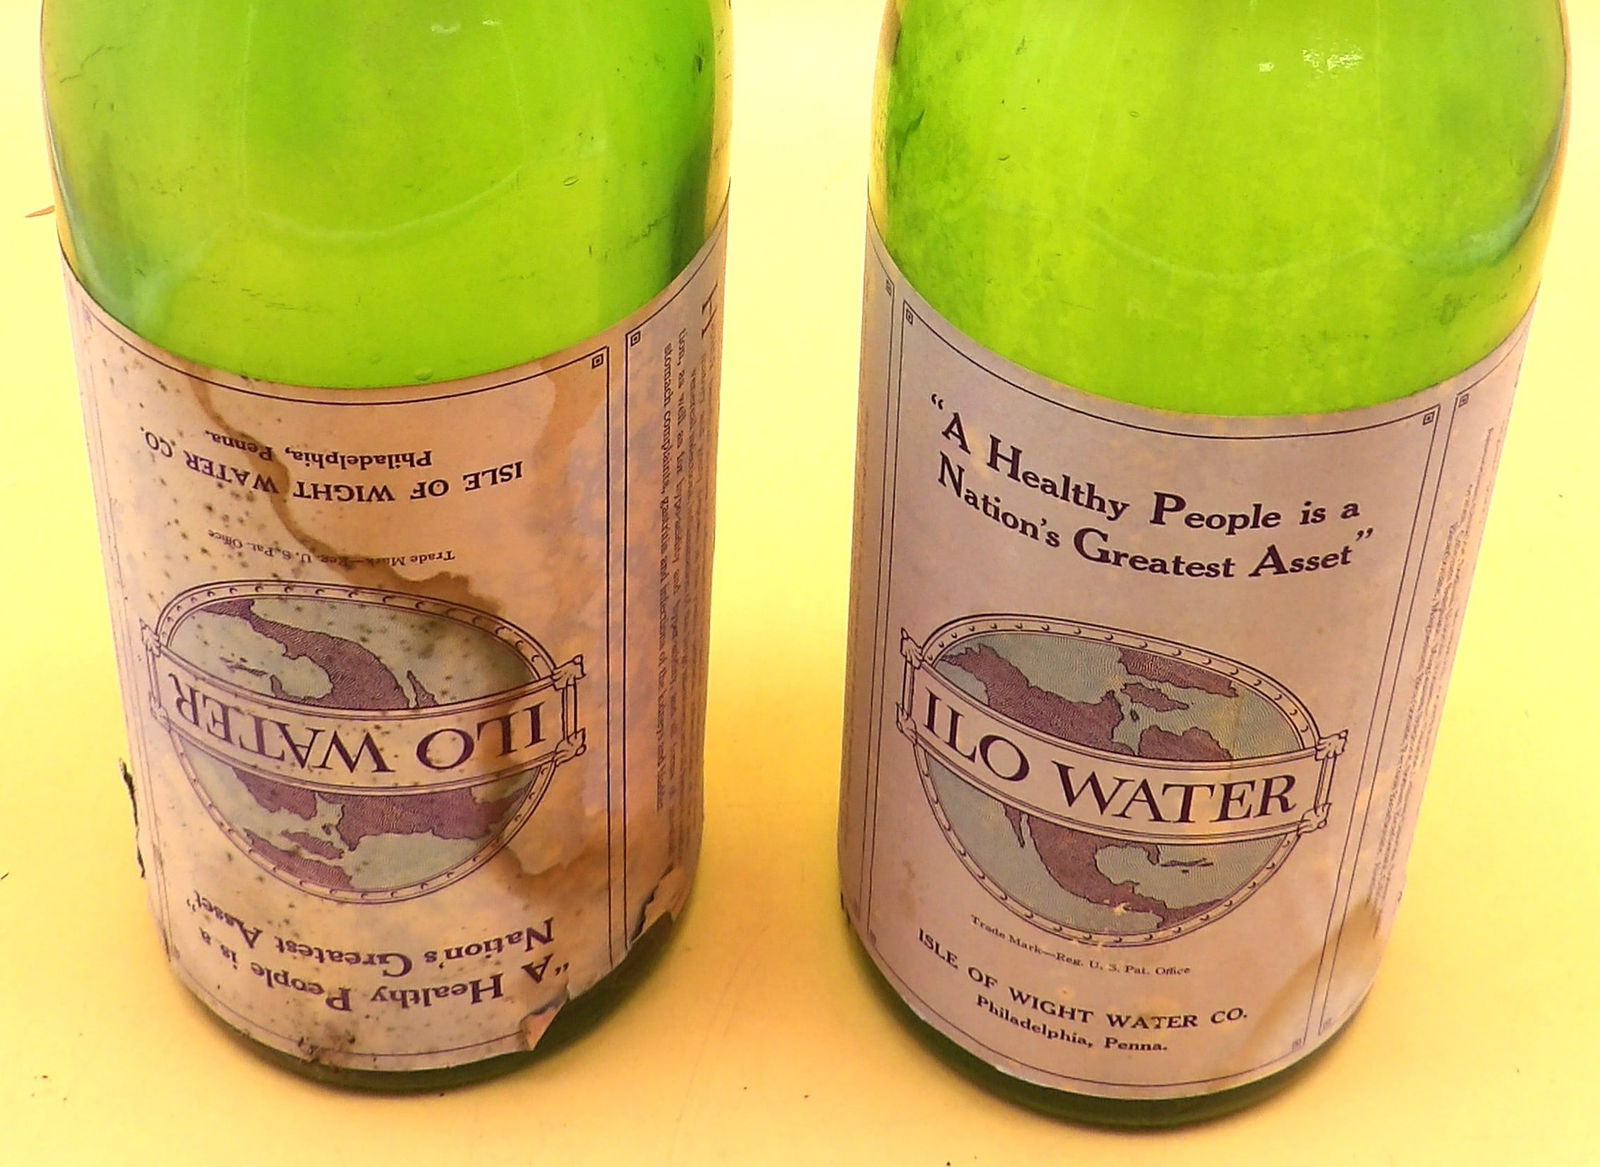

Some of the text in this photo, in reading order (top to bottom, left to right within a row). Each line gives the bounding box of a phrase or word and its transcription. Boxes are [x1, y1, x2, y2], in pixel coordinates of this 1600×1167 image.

[662, 342, 674, 409] stomach
[139, 426, 524, 503] ISLE OF WIGHT WATER CO.
[204, 430, 433, 468] Philadelphia, Penna.
[660, 410, 674, 494] complaints,
[937, 450, 1374, 578] Nation’s Greatest Asset”
[986, 433, 1130, 522] Healthy
[1149, 491, 1282, 536] People
[1299, 499, 1327, 526] is
[1340, 501, 1361, 521] a
[207, 529, 244, 549] Office
[659, 495, 671, 556] gastritis
[410, 550, 456, 567] Trade
[167, 673, 547, 774] ILO WATER
[922, 688, 1298, 825] ILO WATER
[199, 927, 212, 945] a
[219, 943, 239, 970] is
[273, 935, 413, 979] Greatest
[970, 914, 1006, 940] Trade
[1154, 965, 1192, 976] Office
[250, 961, 353, 1013] People
[370, 972, 504, 1011] Healthy
[918, 927, 1248, 1030] ISLE OF WIGHT WATER CO.
[975, 994, 1169, 1052] Philadelphia, Penna.
